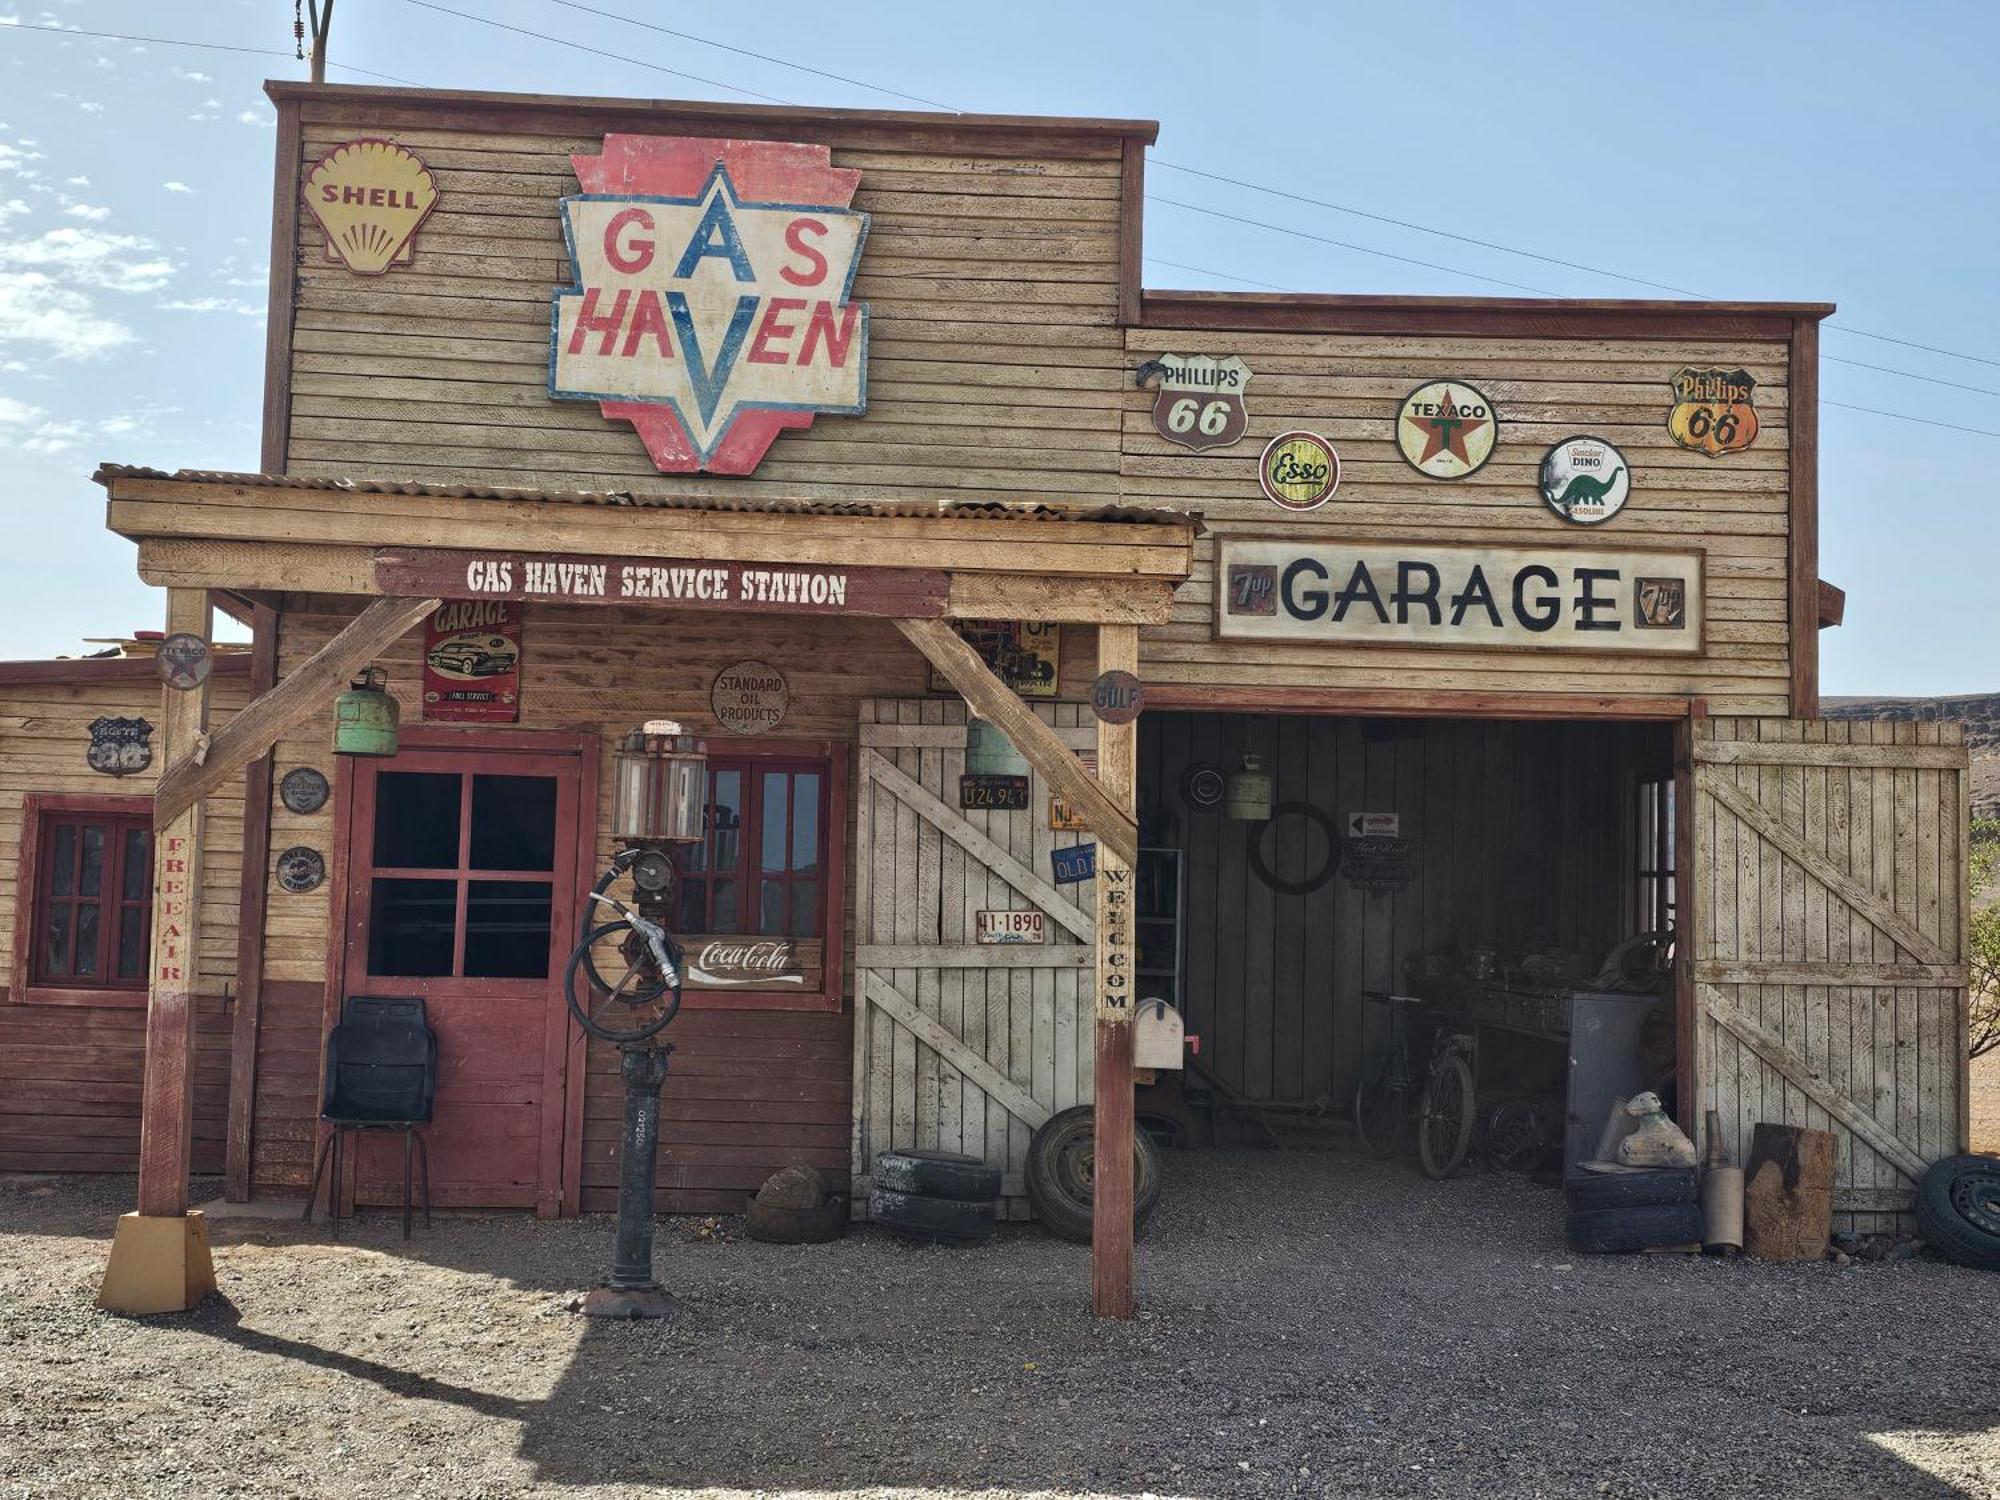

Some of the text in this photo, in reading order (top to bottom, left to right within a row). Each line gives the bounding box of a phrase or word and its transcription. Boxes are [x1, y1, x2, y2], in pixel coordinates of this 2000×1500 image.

[322, 184, 418, 209] SHELL
[603, 189, 829, 287] GAS
[568, 288, 860, 431] HAVEN
[1165, 367, 1239, 387] PHILLIPS
[1683, 376, 1748, 404] Phillips
[1167, 399, 1231, 435] 66
[1411, 402, 1486, 418] TEXACO
[1688, 406, 1740, 445] 66
[1272, 453, 1328, 485] Esso
[1572, 457, 1601, 467] DINO
[467, 560, 847, 605] GAS HAVEN SERVICE STATION
[1281, 557, 1622, 632] GARAGE
[720, 676, 781, 691] STANDARD
[721, 707, 780, 721] PRODUCTS
[741, 694, 760, 705] OIL
[162, 838, 185, 980] FREE AIR
